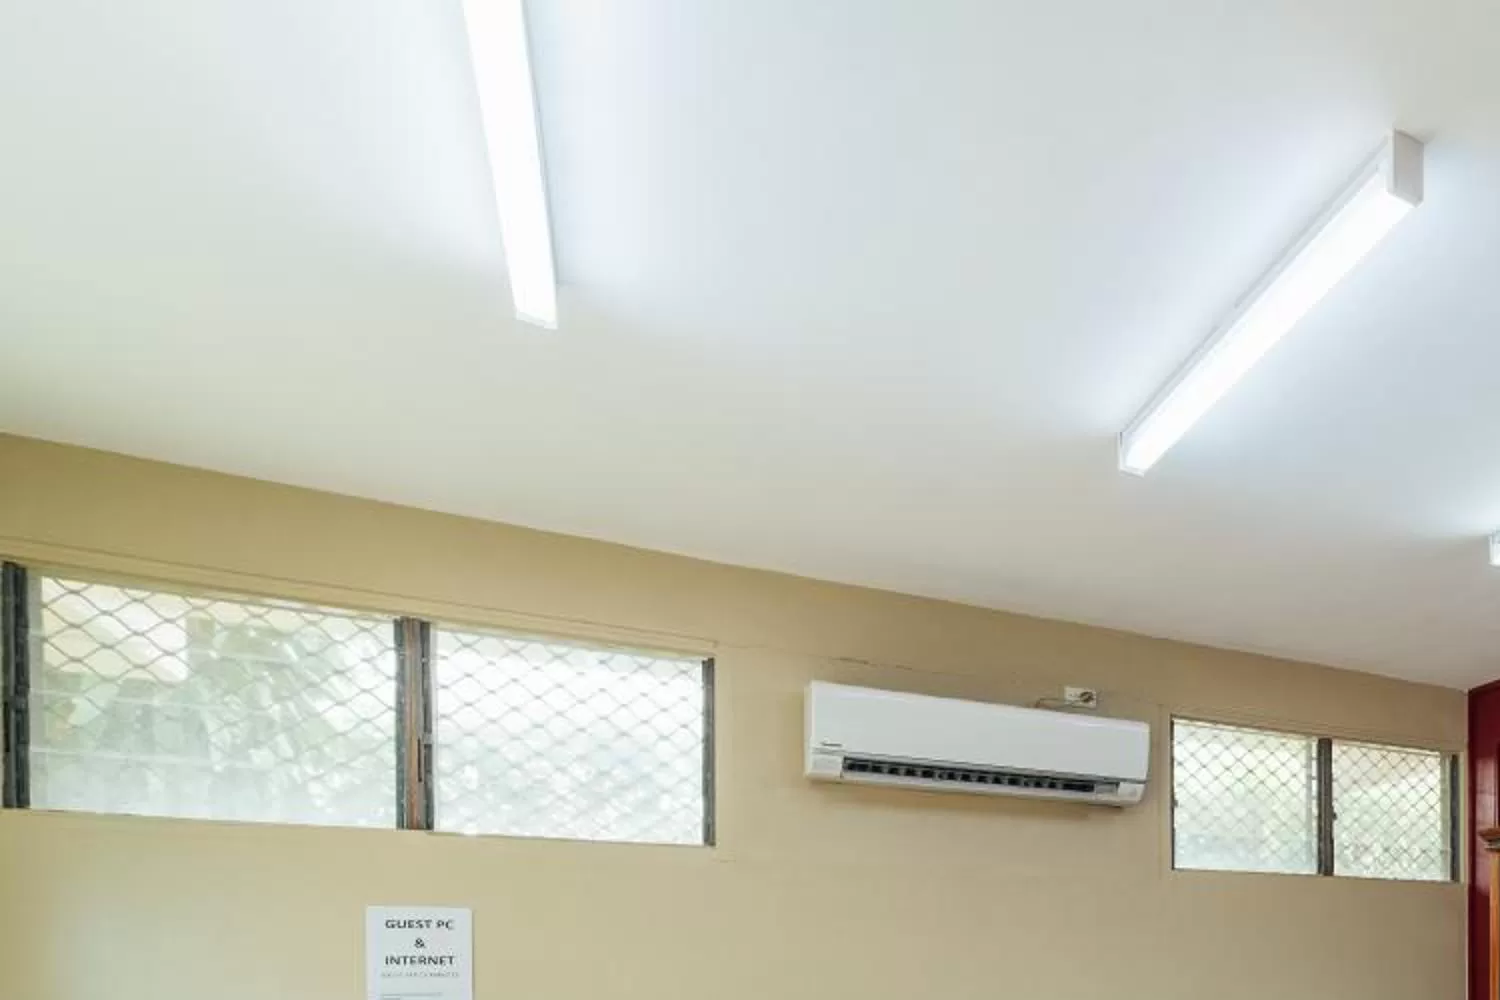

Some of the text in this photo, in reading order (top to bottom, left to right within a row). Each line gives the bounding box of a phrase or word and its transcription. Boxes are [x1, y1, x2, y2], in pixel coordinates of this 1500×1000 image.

[384, 919, 455, 930] GUEST PC
[414, 937, 426, 949] &
[384, 955, 455, 966] INTERNET
